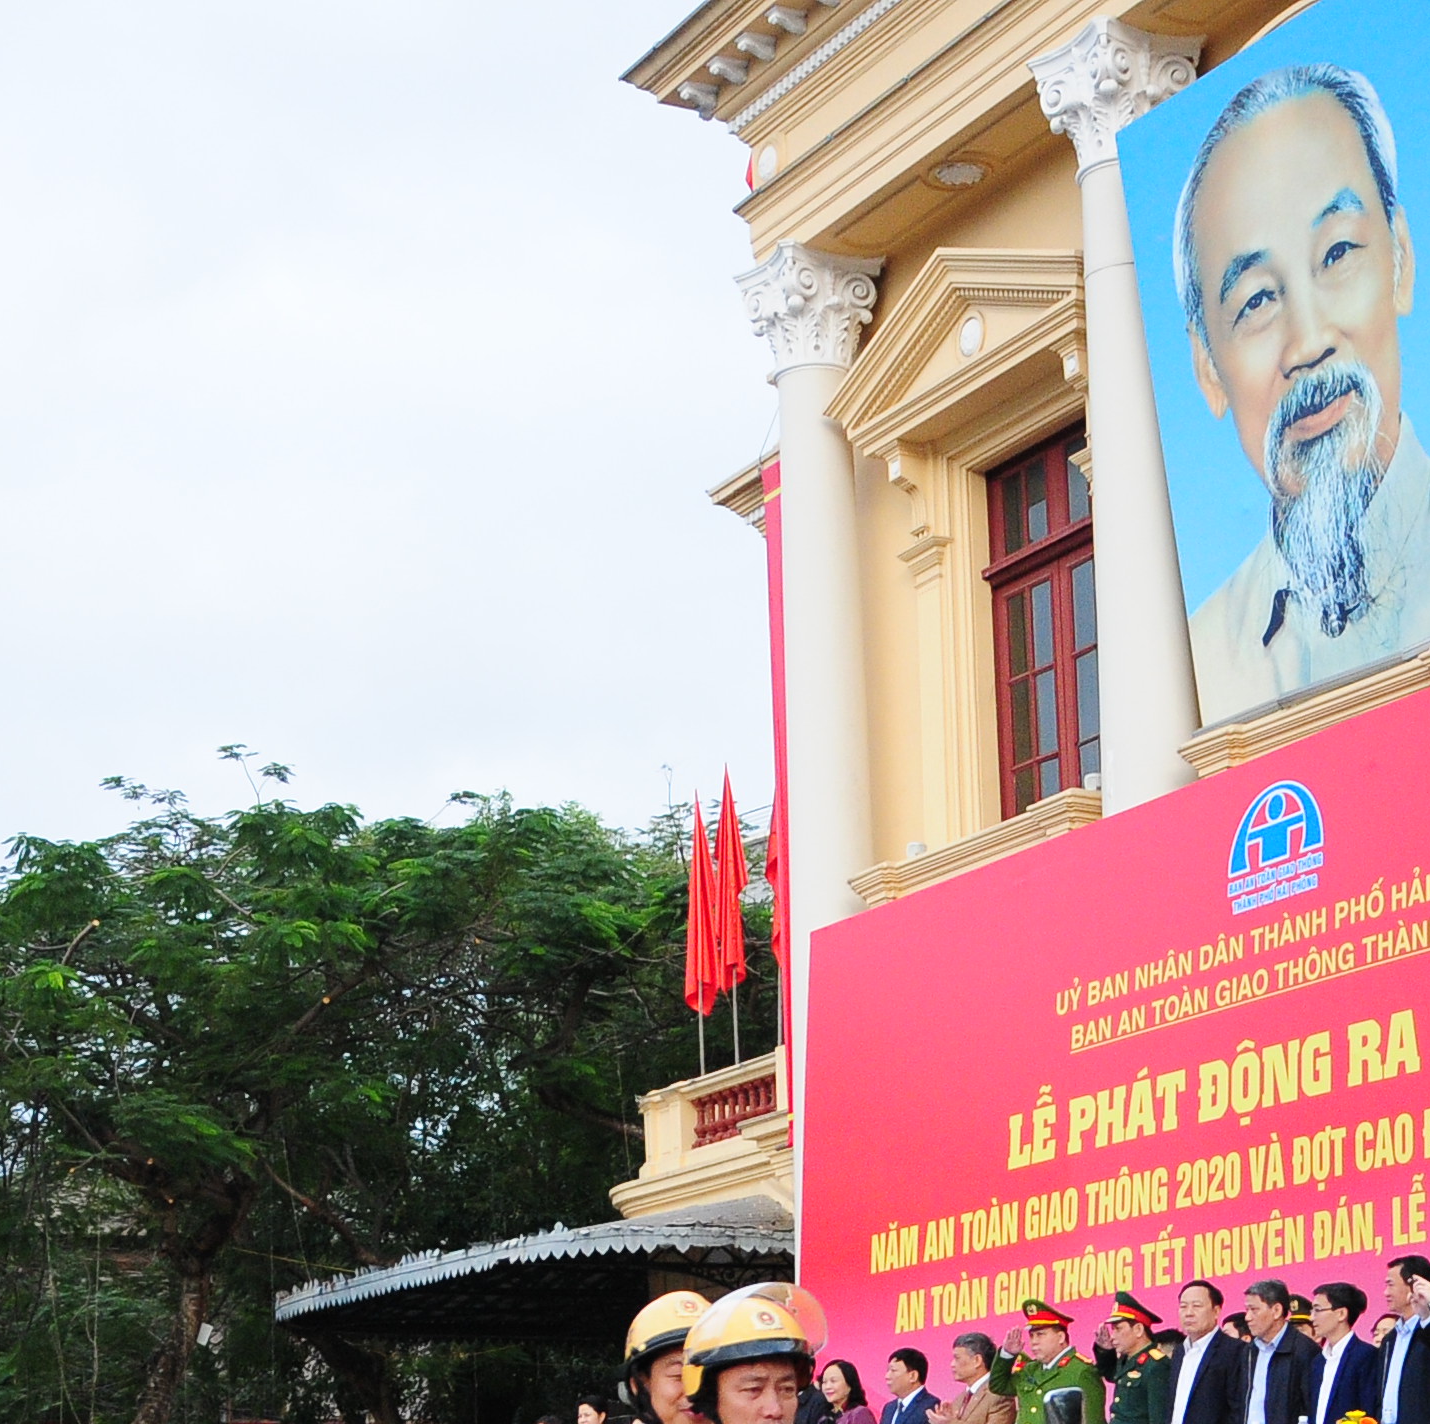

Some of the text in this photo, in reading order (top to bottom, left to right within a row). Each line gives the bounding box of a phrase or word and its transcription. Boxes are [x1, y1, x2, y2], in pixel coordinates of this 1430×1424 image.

[1056, 977, 1082, 1016] UỶ
[1087, 971, 1129, 1007] BAN
[1135, 949, 1193, 991] NHÂN
[1199, 933, 1245, 972] DÂN
[1250, 912, 1327, 955] THÀNH
[1335, 877, 1384, 929] PHỐ
[1072, 1015, 1112, 1050] BAN
[1117, 1005, 1146, 1037] AN
[1152, 986, 1209, 1025] TOÀN
[1215, 968, 1269, 1008] GIAO
[1274, 946, 1355, 990] THÔNG
[1007, 1084, 1057, 1171] LỄ
[1067, 1066, 1187, 1156] PHÁT
[1198, 1030, 1332, 1126] ĐỘNG
[1347, 1008, 1420, 1088] RA
[870, 1220, 918, 1275] NĂM
[923, 1213, 954, 1263] AN
[960, 1197, 1019, 1252] TOÀN
[1024, 1187, 1078, 1240] GIAO
[1085, 1166, 1168, 1227] THÔNG
[1176, 1151, 1242, 1208] 2020
[1248, 1132, 1286, 1195] VÀ
[1291, 1124, 1347, 1192] ĐỢT
[1354, 1111, 1414, 1173] CAO
[895, 1288, 926, 1334] AN
[931, 1271, 988, 1325] TOÀN
[994, 1264, 1046, 1315] GIAO
[1052, 1244, 1134, 1309] THÔNG
[1140, 1224, 1188, 1286] TẾT
[1193, 1208, 1307, 1283] NGUYÊN
[1312, 1195, 1383, 1261] ĐÁN,
[1390, 1173, 1428, 1248] LỄ
